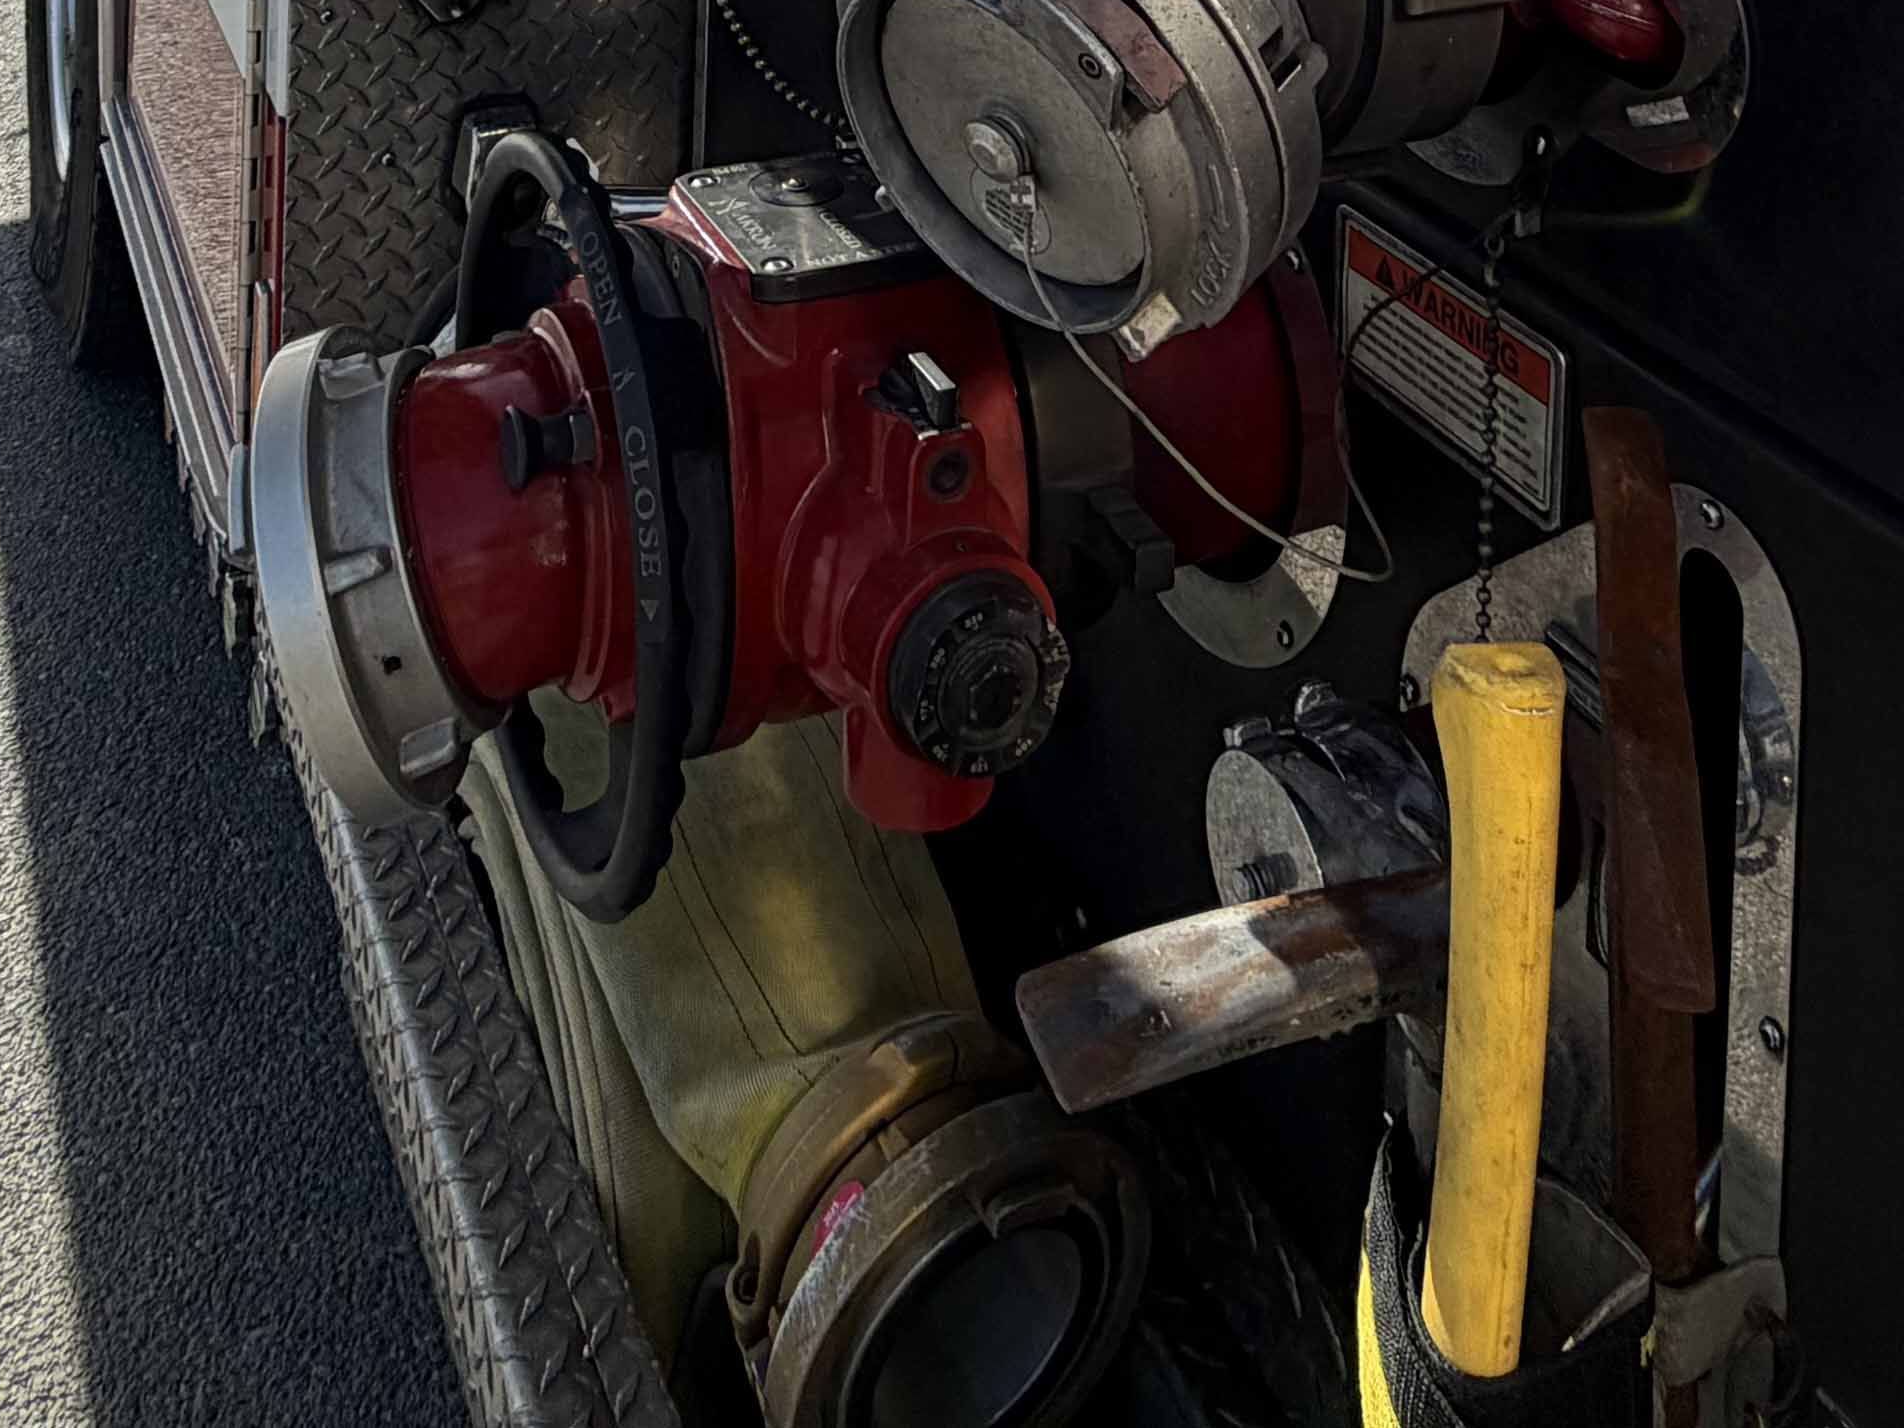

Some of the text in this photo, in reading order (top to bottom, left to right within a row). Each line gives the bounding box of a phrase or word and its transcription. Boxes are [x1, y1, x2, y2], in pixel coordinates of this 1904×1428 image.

[579, 230, 624, 326] OPEN
[1190, 239, 1233, 306] LOCK
[622, 423, 663, 577] CLOSE
